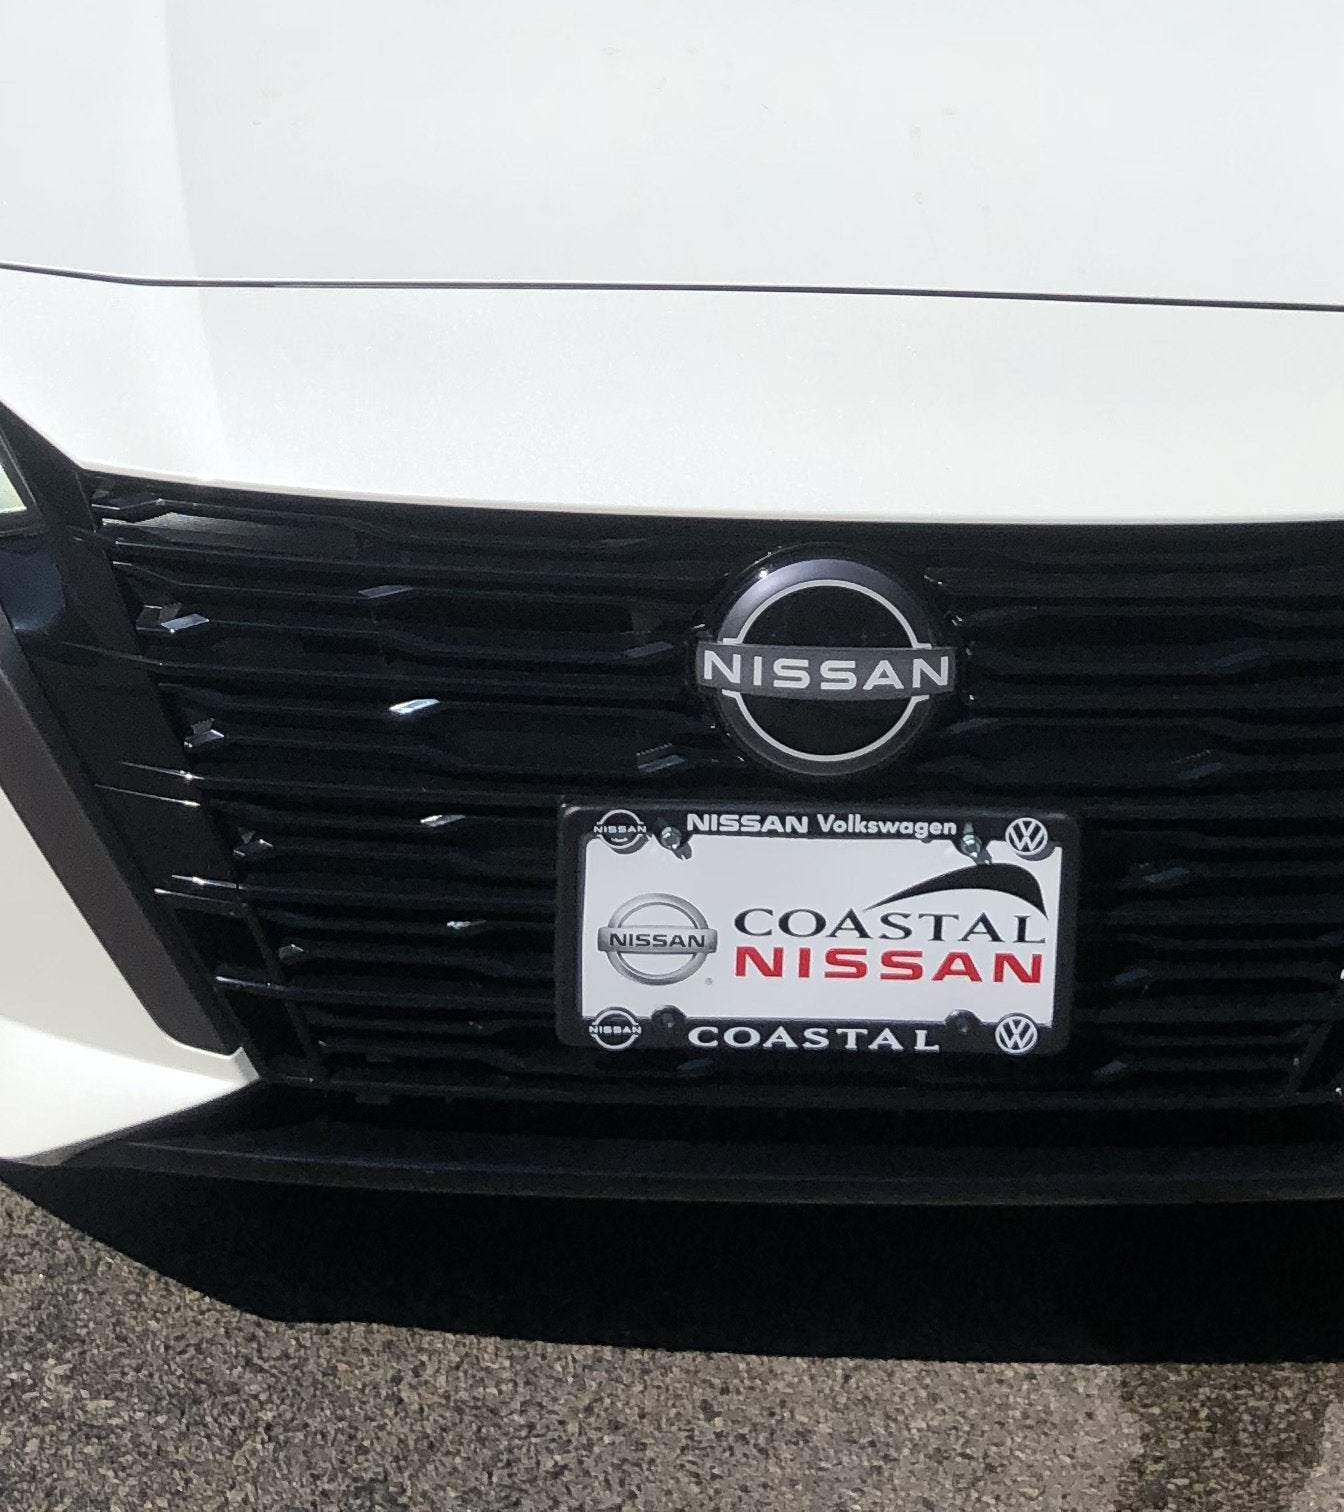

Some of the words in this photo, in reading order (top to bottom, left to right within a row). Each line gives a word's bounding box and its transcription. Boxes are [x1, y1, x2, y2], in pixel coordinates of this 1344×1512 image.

[703, 649, 950, 691] NISSAN
[593, 824, 647, 834] NISSAN
[686, 813, 809, 834] NISSAN
[816, 813, 957, 838] Volkswagen
[733, 907, 1047, 944] COASTAL
[609, 932, 706, 949] NISSAN
[734, 945, 1042, 984] NISSAN
[588, 1024, 642, 1035] NISSAN
[687, 1025, 940, 1053] COASTAL
